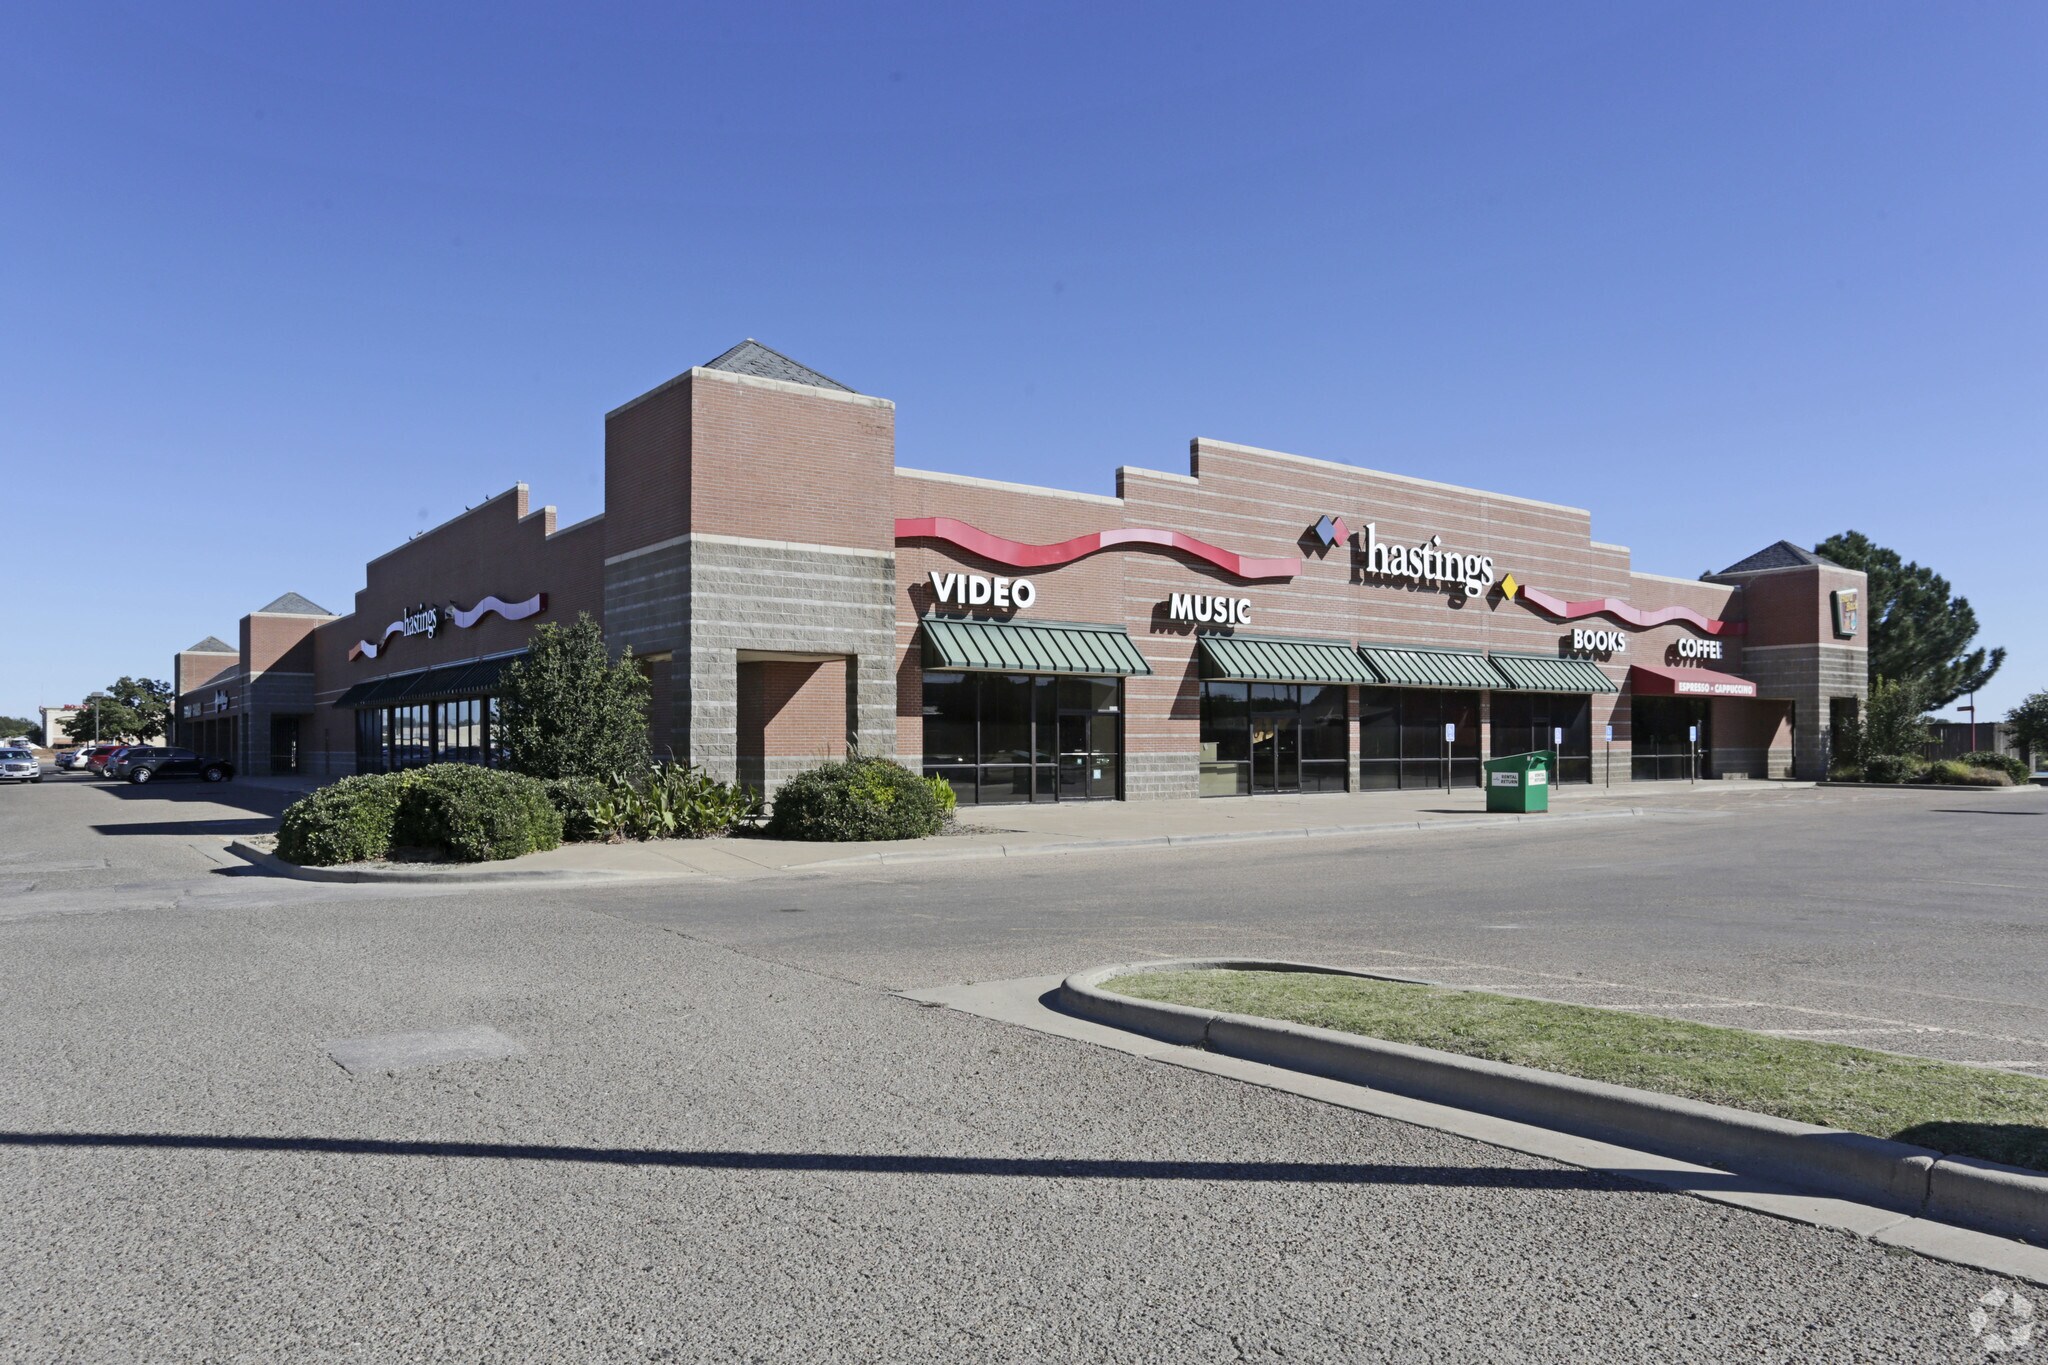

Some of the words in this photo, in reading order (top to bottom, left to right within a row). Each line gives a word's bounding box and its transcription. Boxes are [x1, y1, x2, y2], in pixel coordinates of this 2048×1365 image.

[1365, 521, 1494, 598] hastings
[929, 571, 1036, 608] VIDEO
[403, 603, 437, 639] hastings
[1169, 592, 1251, 625] MUSIC
[1573, 628, 1626, 652] BOOKS
[1678, 638, 1723, 660] COFFEE
[1678, 681, 1710, 693] ESPRESSO
[1714, 683, 1753, 695] CAPPUCCINO
